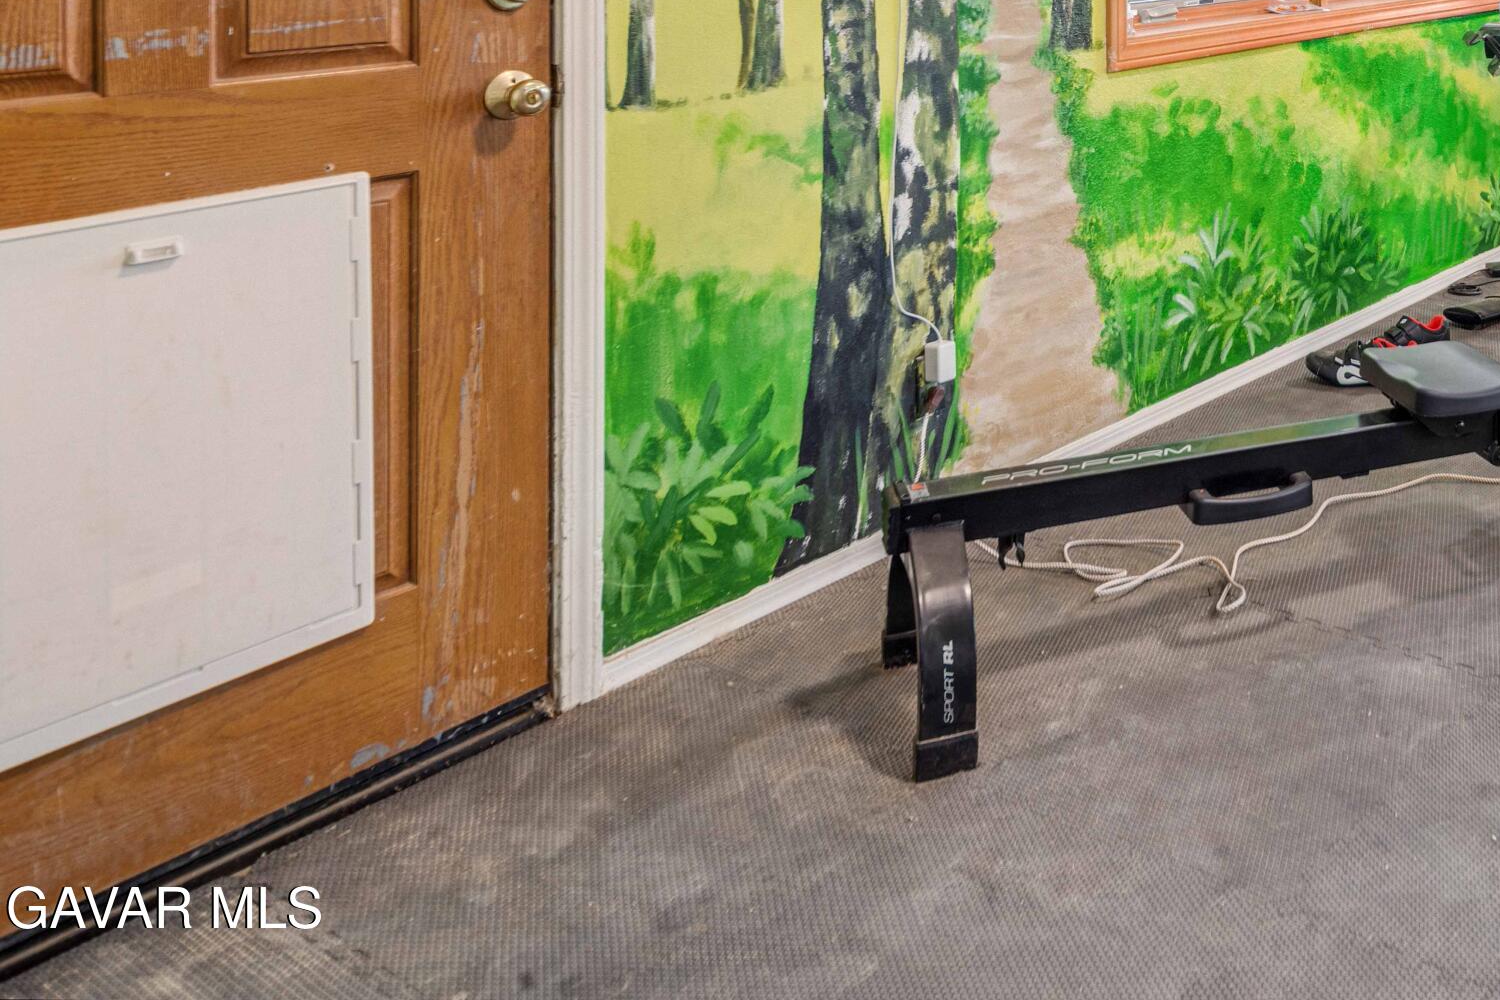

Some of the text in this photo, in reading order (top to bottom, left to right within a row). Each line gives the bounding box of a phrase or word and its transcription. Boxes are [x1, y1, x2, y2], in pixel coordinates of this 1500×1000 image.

[981, 444, 1192, 485] PRO-FORM
[942, 639, 955, 724] SPORT RL
